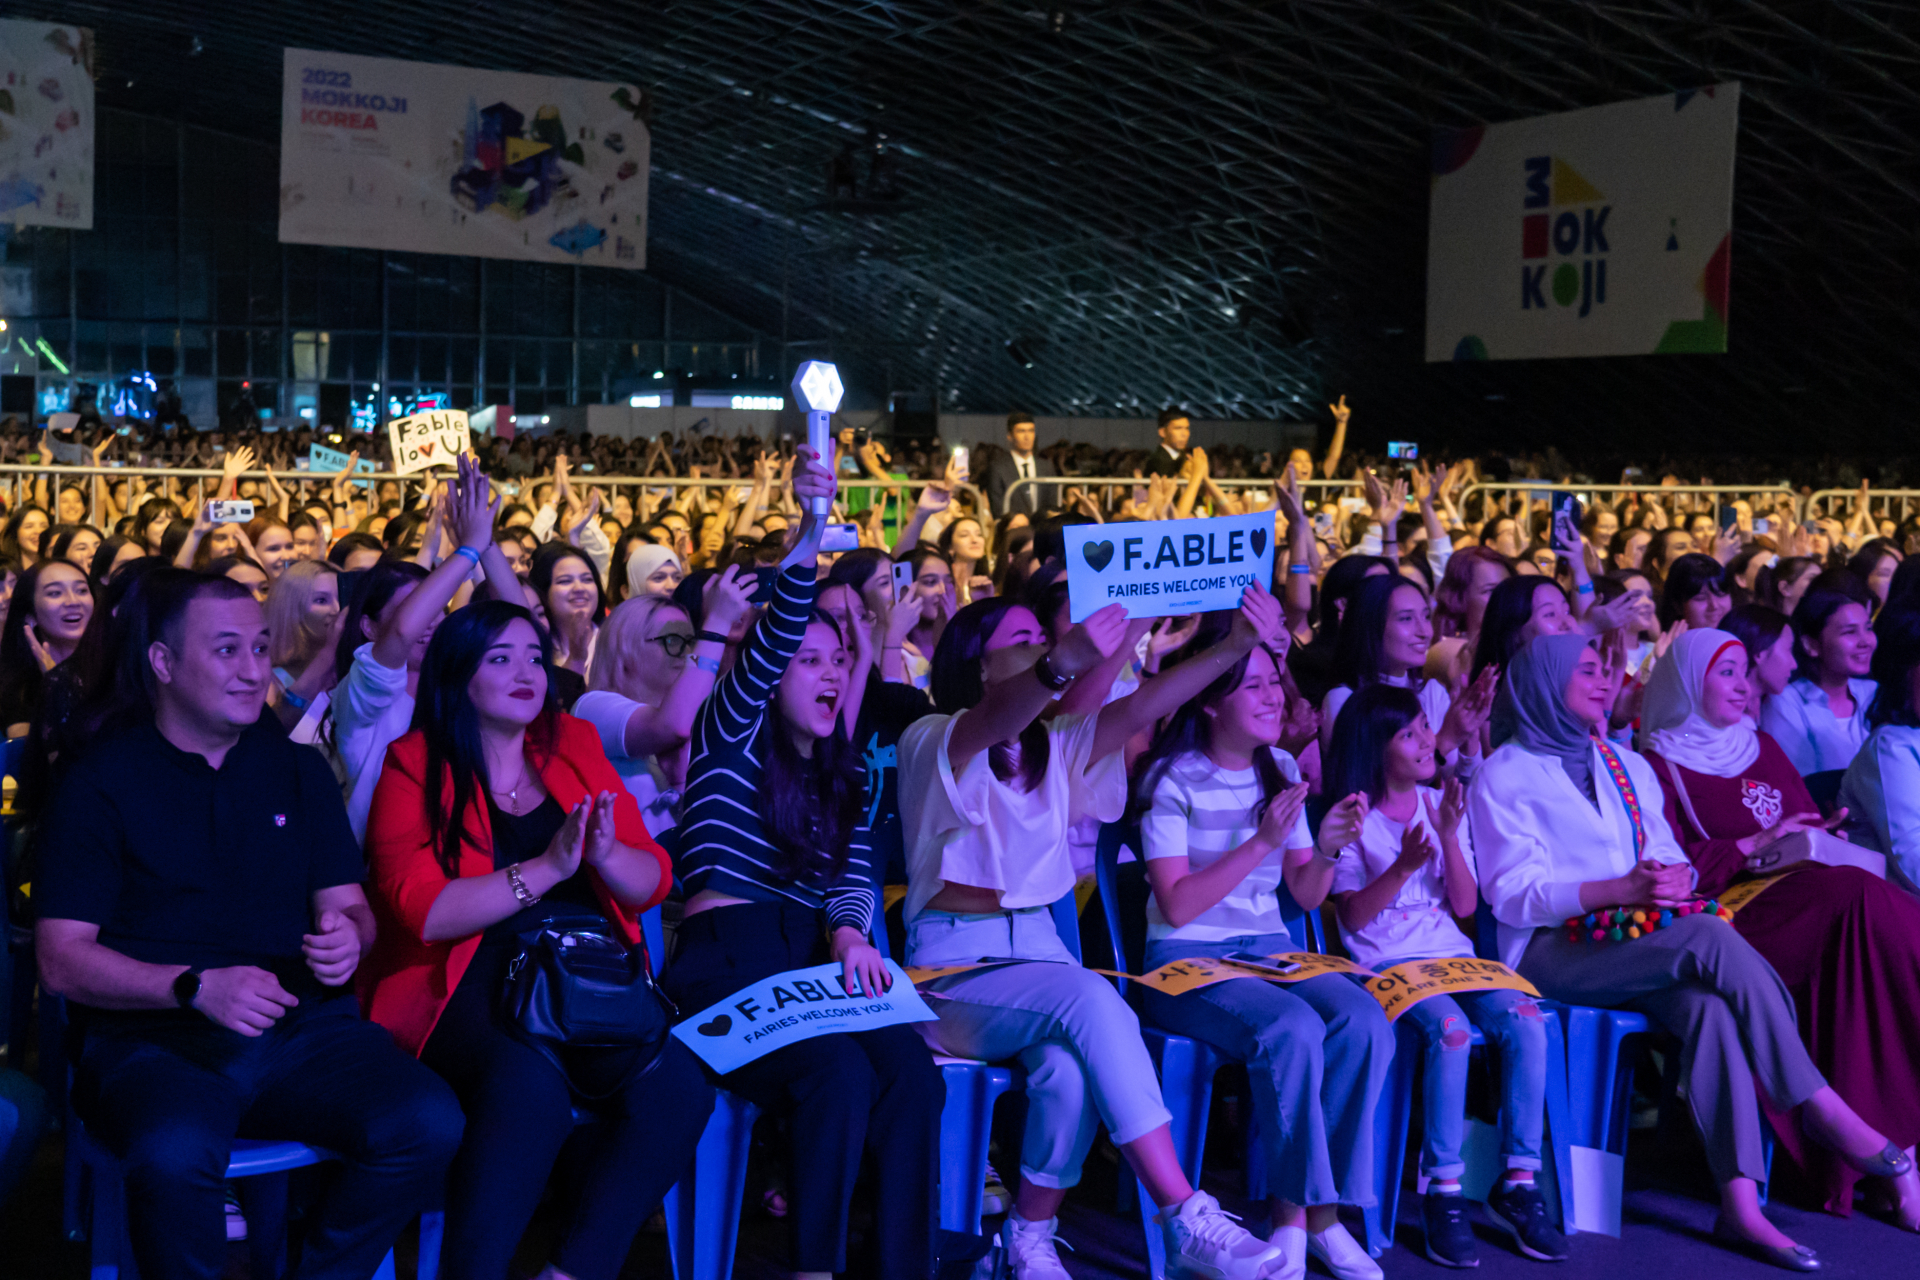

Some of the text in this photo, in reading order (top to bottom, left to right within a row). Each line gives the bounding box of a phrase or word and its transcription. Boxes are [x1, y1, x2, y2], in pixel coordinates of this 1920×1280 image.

[302, 67, 352, 88] 2022
[301, 88, 407, 113] MOKKOJI
[301, 108, 378, 130] KOREA
[1522, 259, 1606, 318] KOJI
[397, 413, 464, 443] Fable
[1124, 530, 1244, 571] F.ABLE
[1107, 582, 1160, 598] FAIRIES
[1163, 576, 1226, 594] WELCOME
[1407, 981, 1438, 995] ARE
[1440, 976, 1476, 985] ONE
[743, 1016, 799, 1044] FAIRIES
[798, 1005, 861, 1022] WELCOME
[860, 1002, 894, 1015] YOU!
